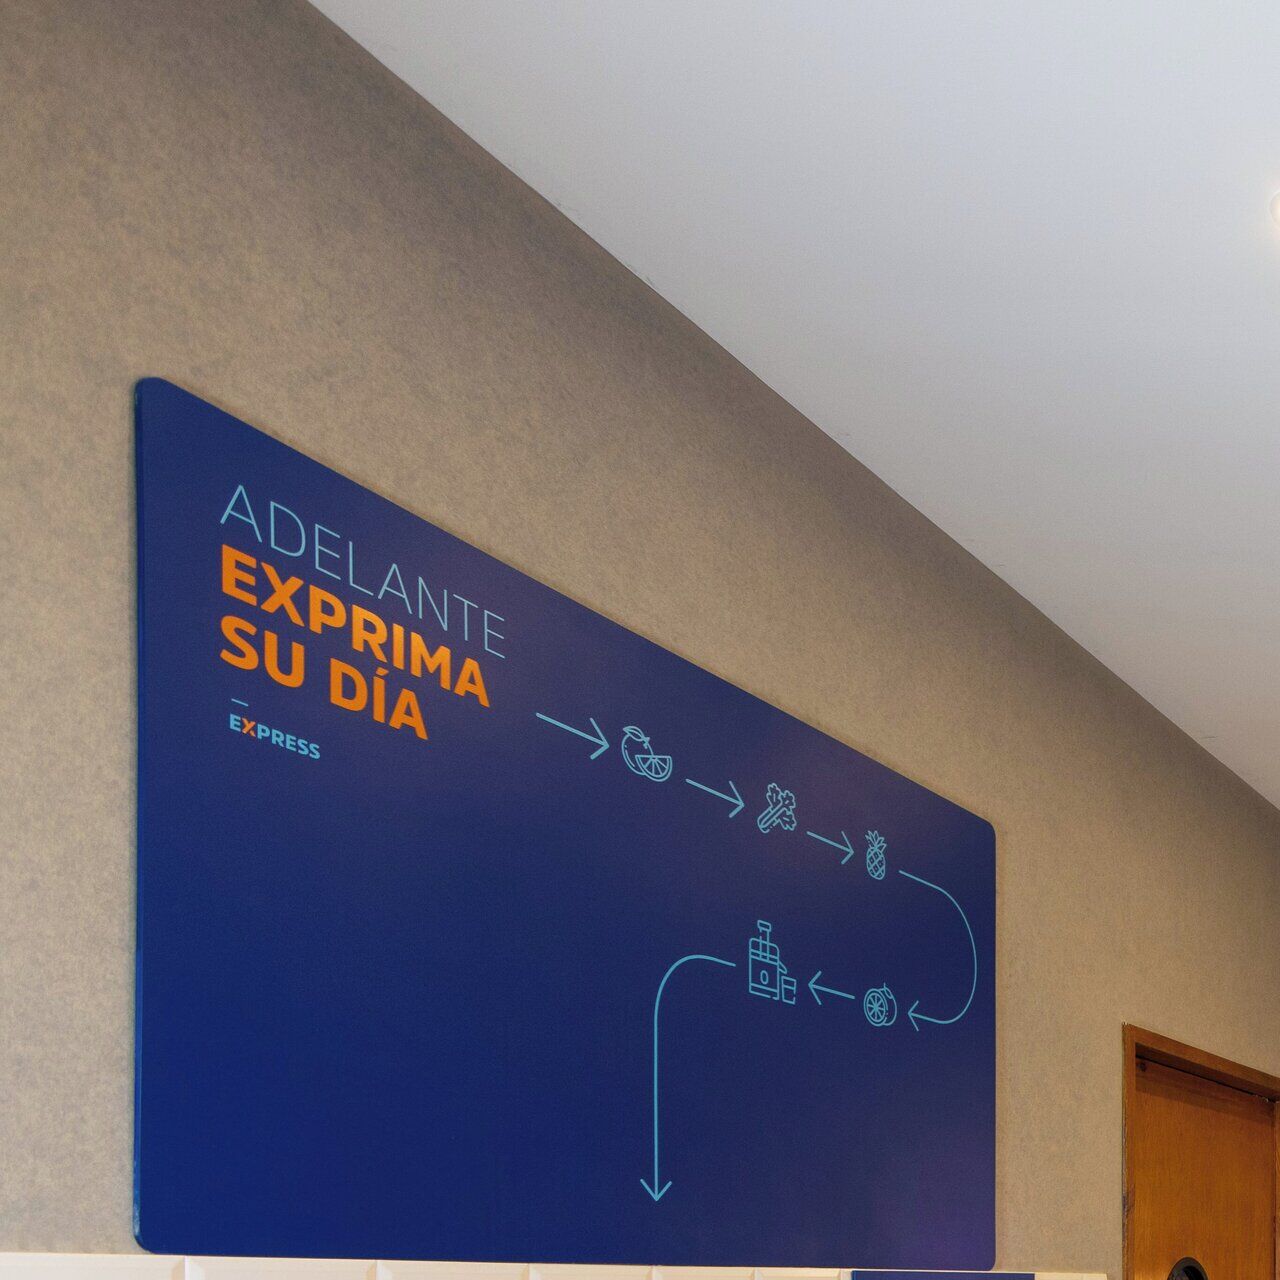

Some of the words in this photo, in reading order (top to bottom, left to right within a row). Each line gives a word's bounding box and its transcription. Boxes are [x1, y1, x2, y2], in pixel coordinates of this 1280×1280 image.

[220, 485, 506, 659] ADELANTE
[221, 543, 490, 708] EXPRIMA
[219, 615, 305, 688] SU
[330, 657, 428, 741] DÍA
[229, 713, 321, 760] EXPRESS
